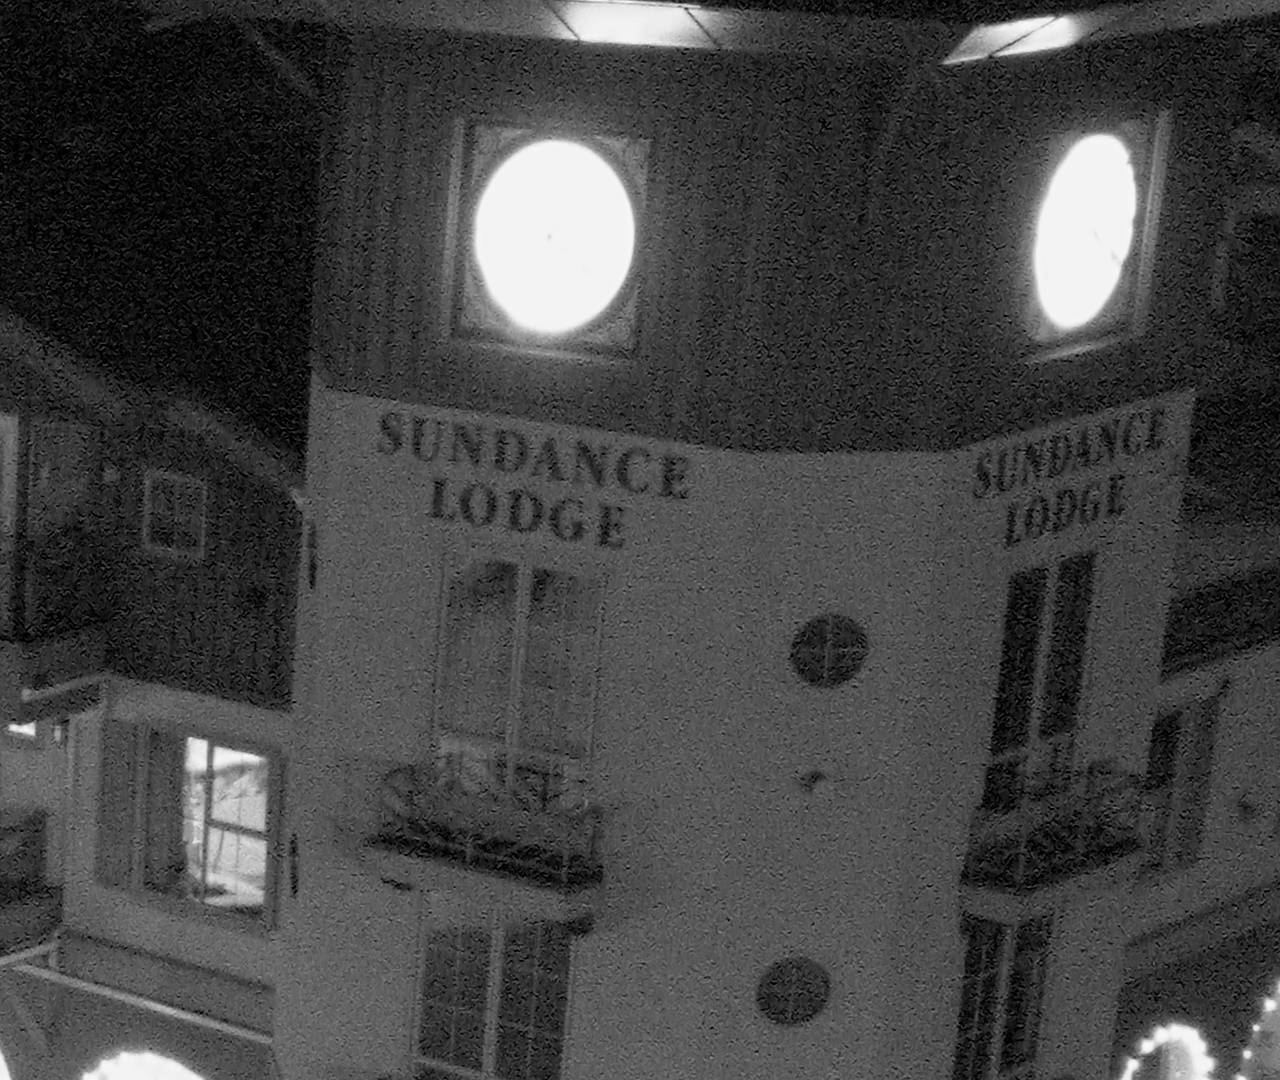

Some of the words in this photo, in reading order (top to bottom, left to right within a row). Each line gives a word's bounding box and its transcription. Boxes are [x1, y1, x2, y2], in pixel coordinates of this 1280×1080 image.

[377, 412, 691, 500] SUNDANCE
[973, 408, 1165, 500] SUNDANCE
[428, 478, 626, 549] LODGE
[1004, 473, 1125, 550] LODGE
